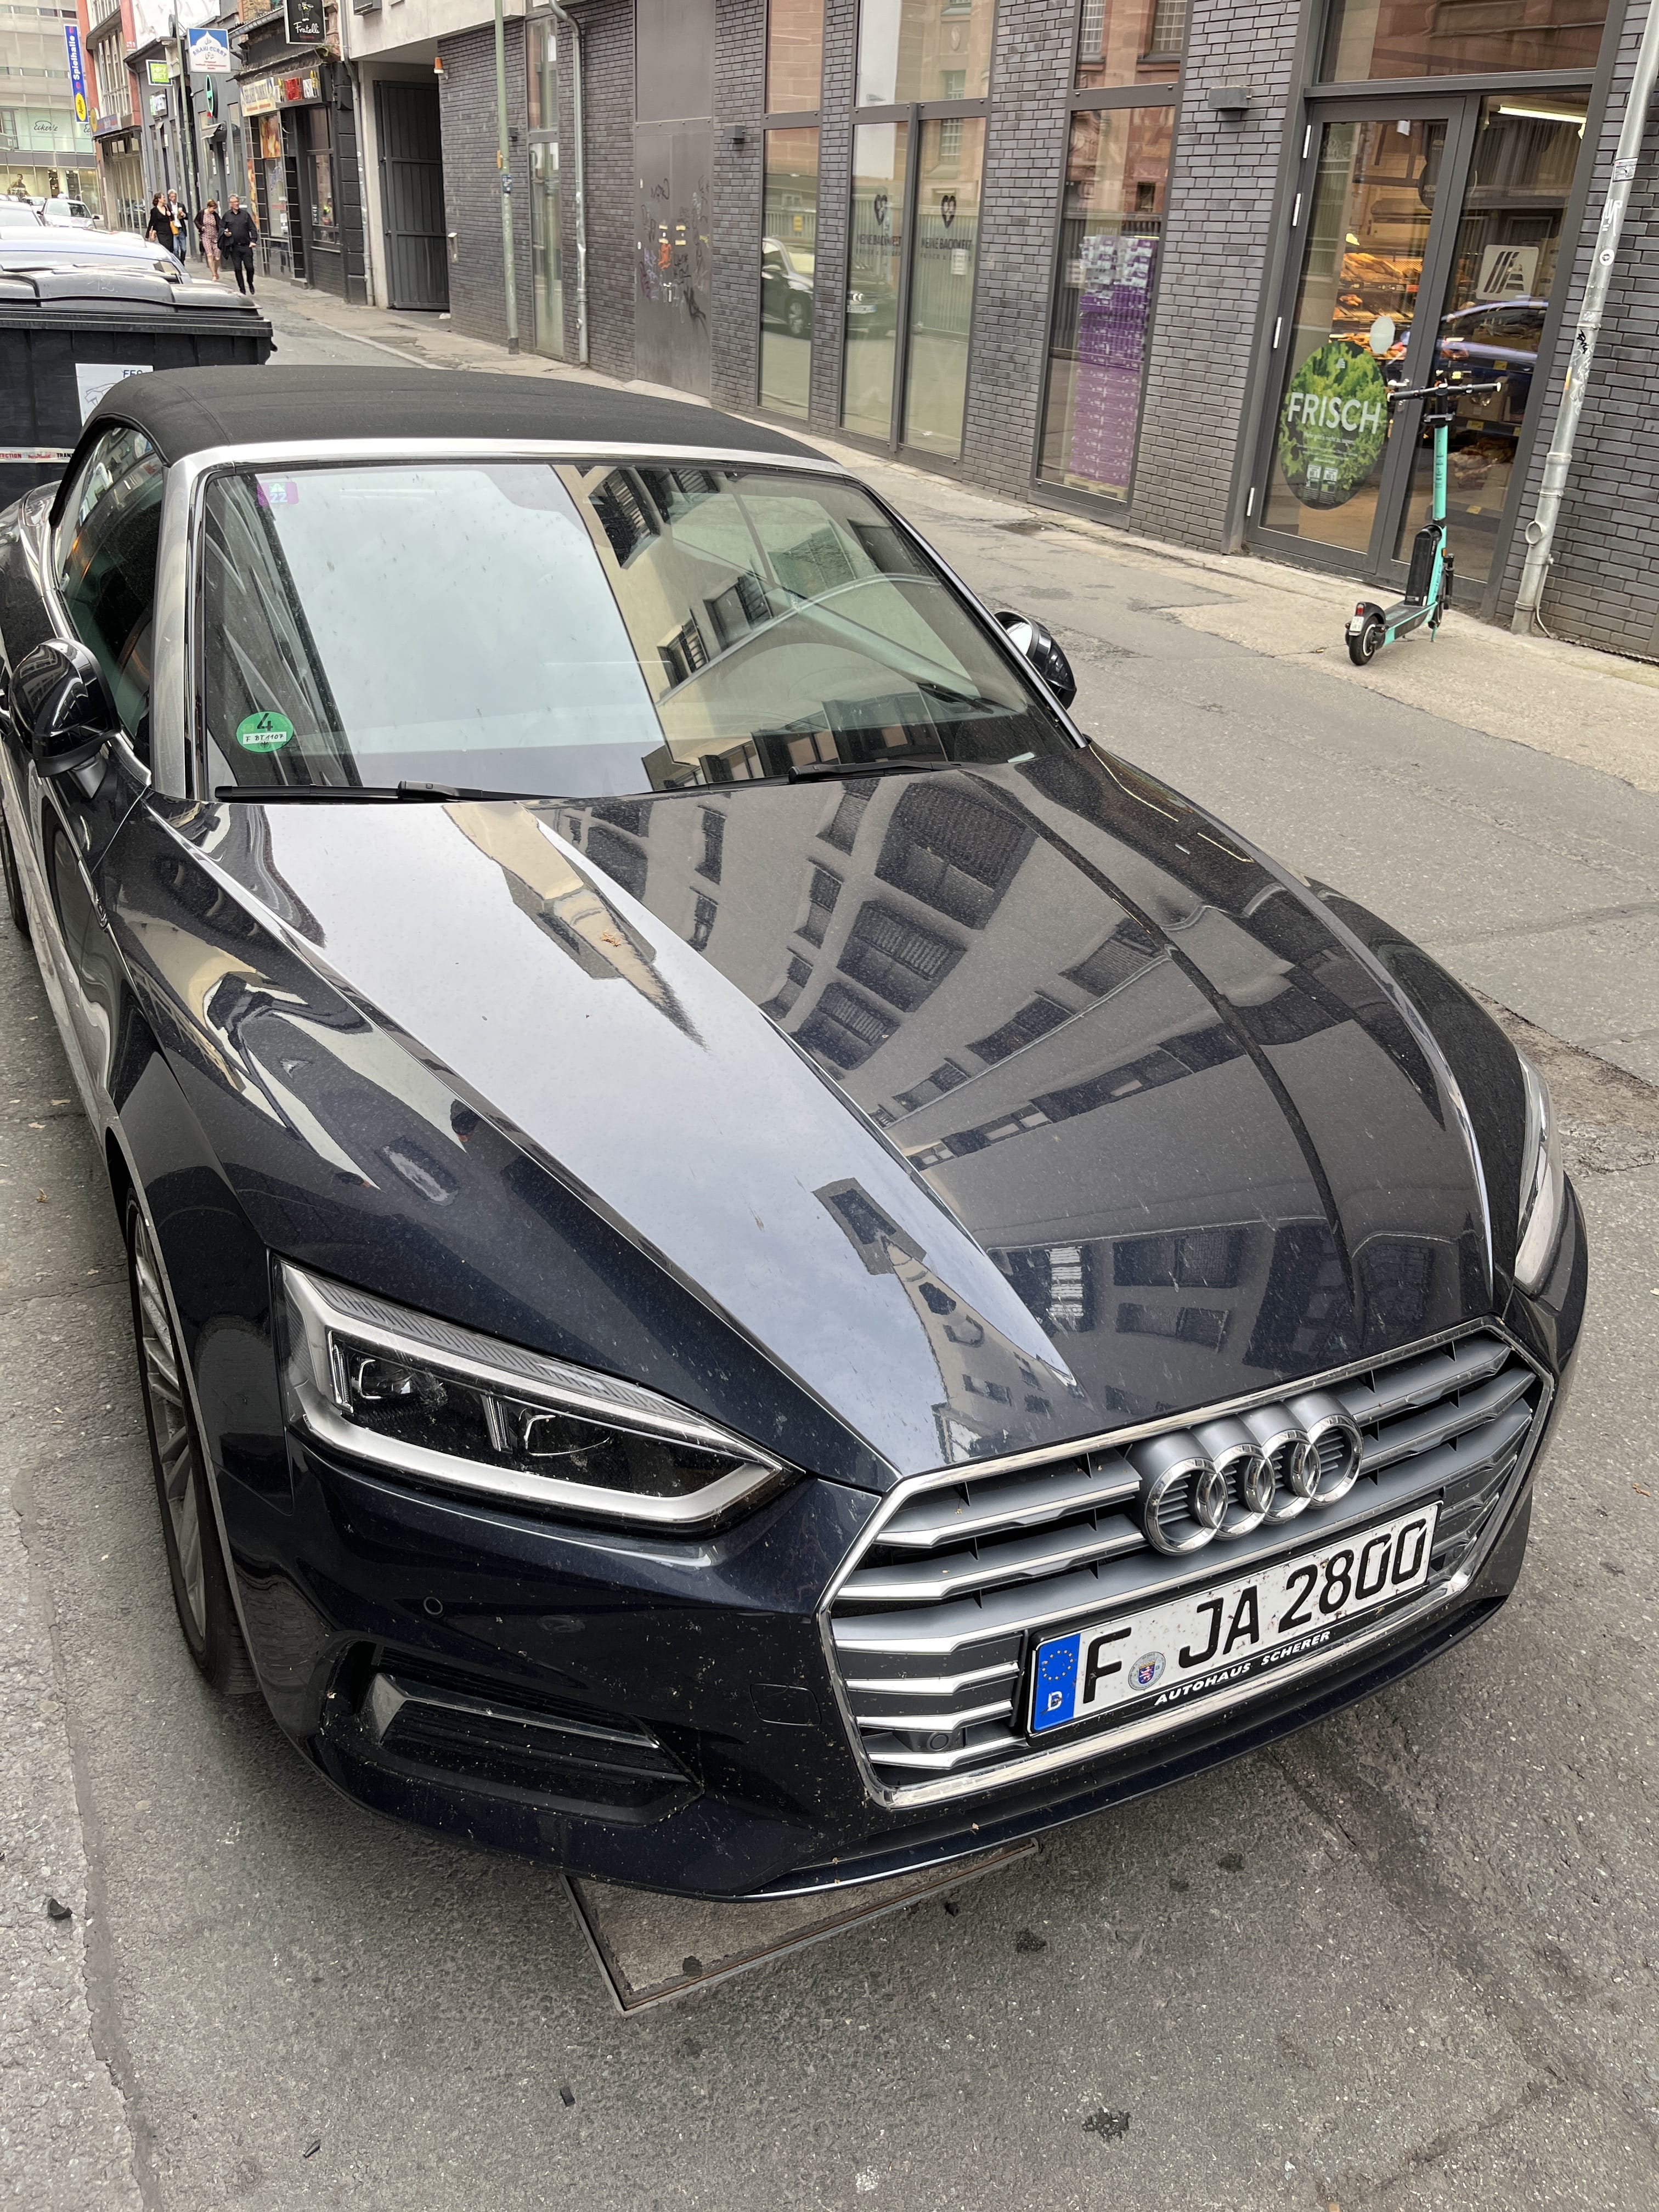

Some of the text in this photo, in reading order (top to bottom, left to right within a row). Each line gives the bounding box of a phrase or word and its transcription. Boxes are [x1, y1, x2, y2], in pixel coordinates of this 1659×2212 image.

[293, 21, 320, 33] Fratelli
[70, 35, 81, 81] Spielhalle
[1288, 392, 1381, 434] FRISCH
[270, 492, 287, 503] 22
[257, 713, 273, 731] 4
[1083, 1627, 1132, 1704] F
[1178, 1587, 1260, 1668] JA
[1278, 1519, 1426, 1633] 2800
[1154, 1663, 1251, 1706] AUTOHAUS
[1260, 1630, 1331, 1666] SCHERER
[1047, 1691, 1063, 1711] D
